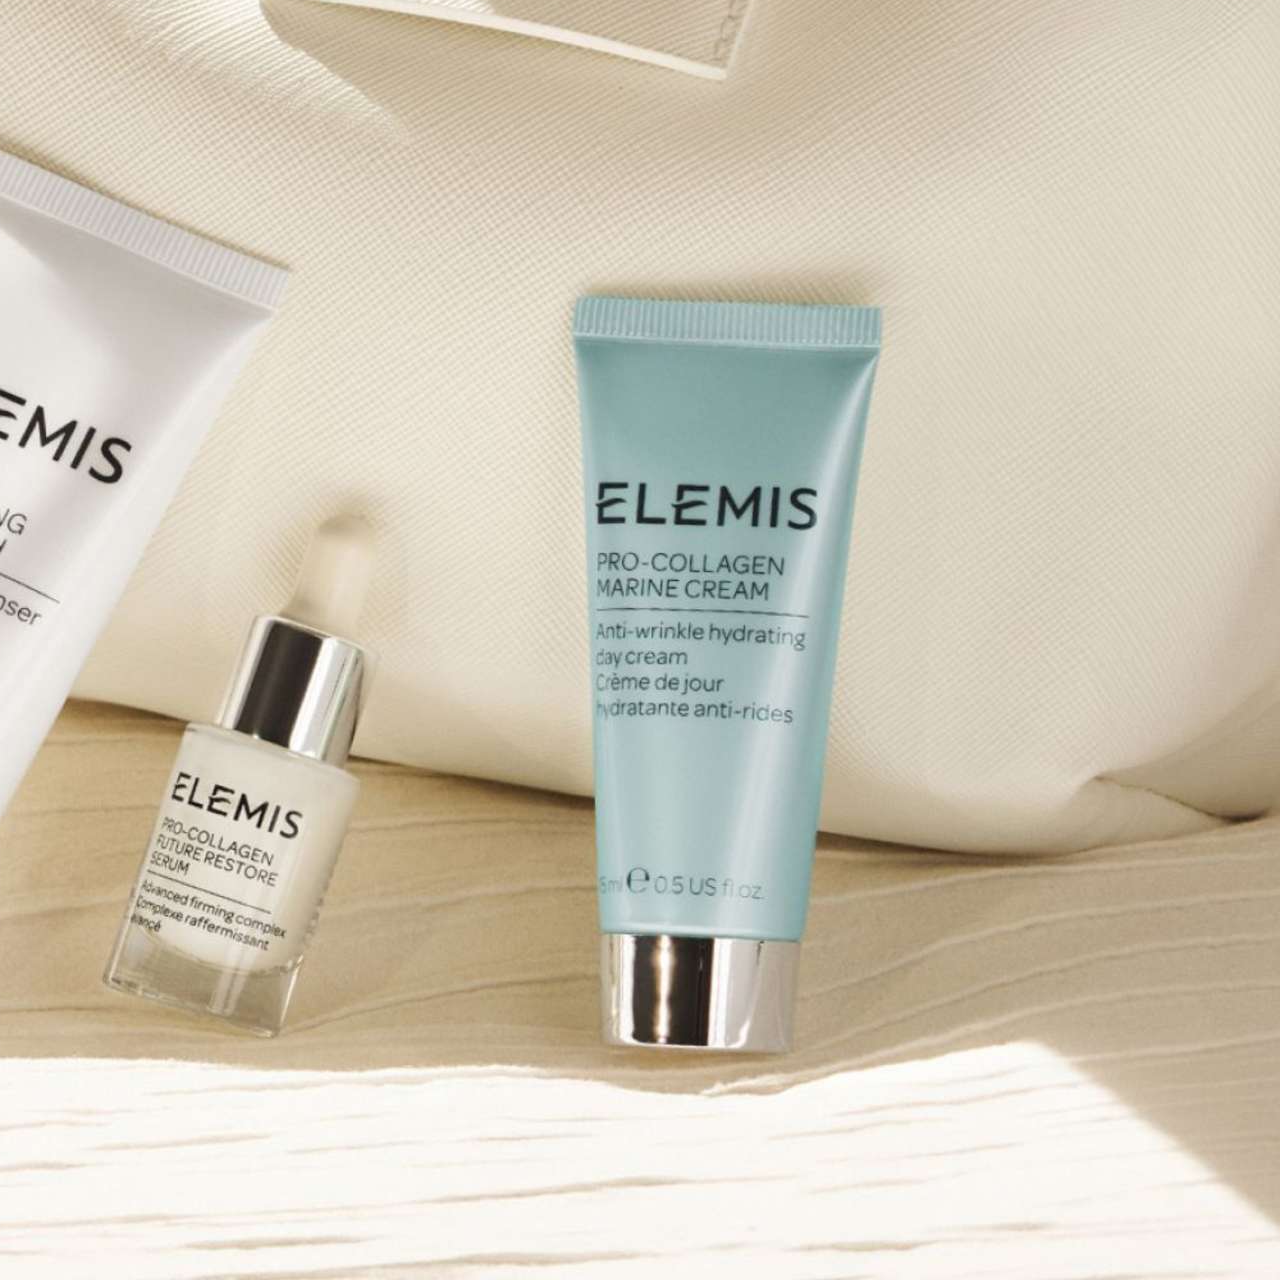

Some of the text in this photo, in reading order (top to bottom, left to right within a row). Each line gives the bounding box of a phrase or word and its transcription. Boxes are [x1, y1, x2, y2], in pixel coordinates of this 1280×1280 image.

[595, 482, 818, 531] ELEMIS
[597, 551, 785, 576] PRO-COLLAGEN
[596, 578, 769, 601] MARINE CREAM
[596, 621, 806, 652] Anti-wrinkle hydrating
[596, 649, 688, 668] day cream
[596, 672, 724, 695] Crème de jour
[694, 700, 793, 724] anti-rides
[171, 771, 303, 839] ELEMIS
[161, 816, 275, 867] PRO-COLLAGEN
[149, 851, 190, 876] SERUM
[156, 834, 279, 887] FUTURE RESTORE
[689, 877, 717, 897] US
[136, 895, 270, 951] Complexe raffermissant
[141, 879, 287, 939] Advanced firming complex
